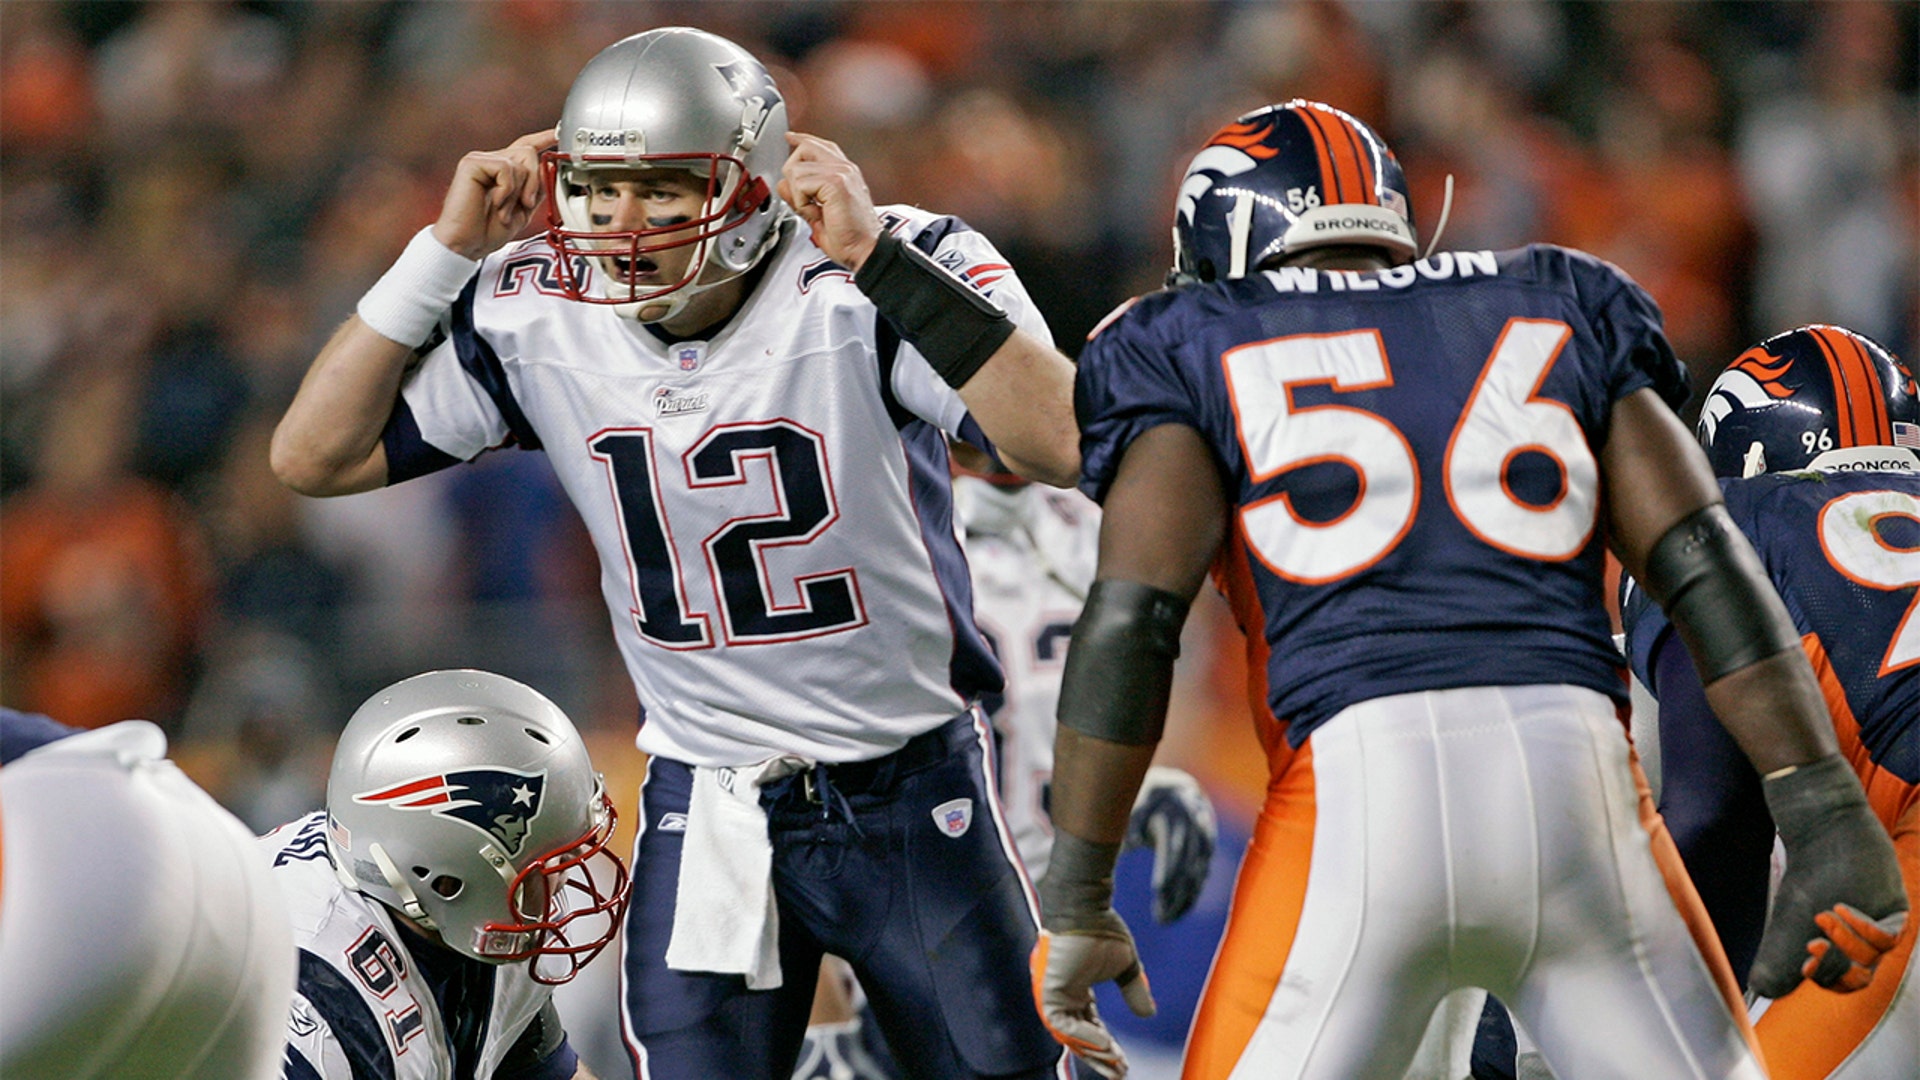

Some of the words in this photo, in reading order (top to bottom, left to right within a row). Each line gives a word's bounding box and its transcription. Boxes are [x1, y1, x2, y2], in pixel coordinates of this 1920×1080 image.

[589, 132, 625, 146] Riddell
[1287, 186, 1320, 214] 56
[1314, 217, 1399, 235] BRONCOS
[1262, 250, 1498, 293] WILSON
[1221, 316, 1600, 586] 56
[1801, 428, 1833, 454] 96
[587, 417, 869, 651] 12
[345, 925, 424, 1056] 61
